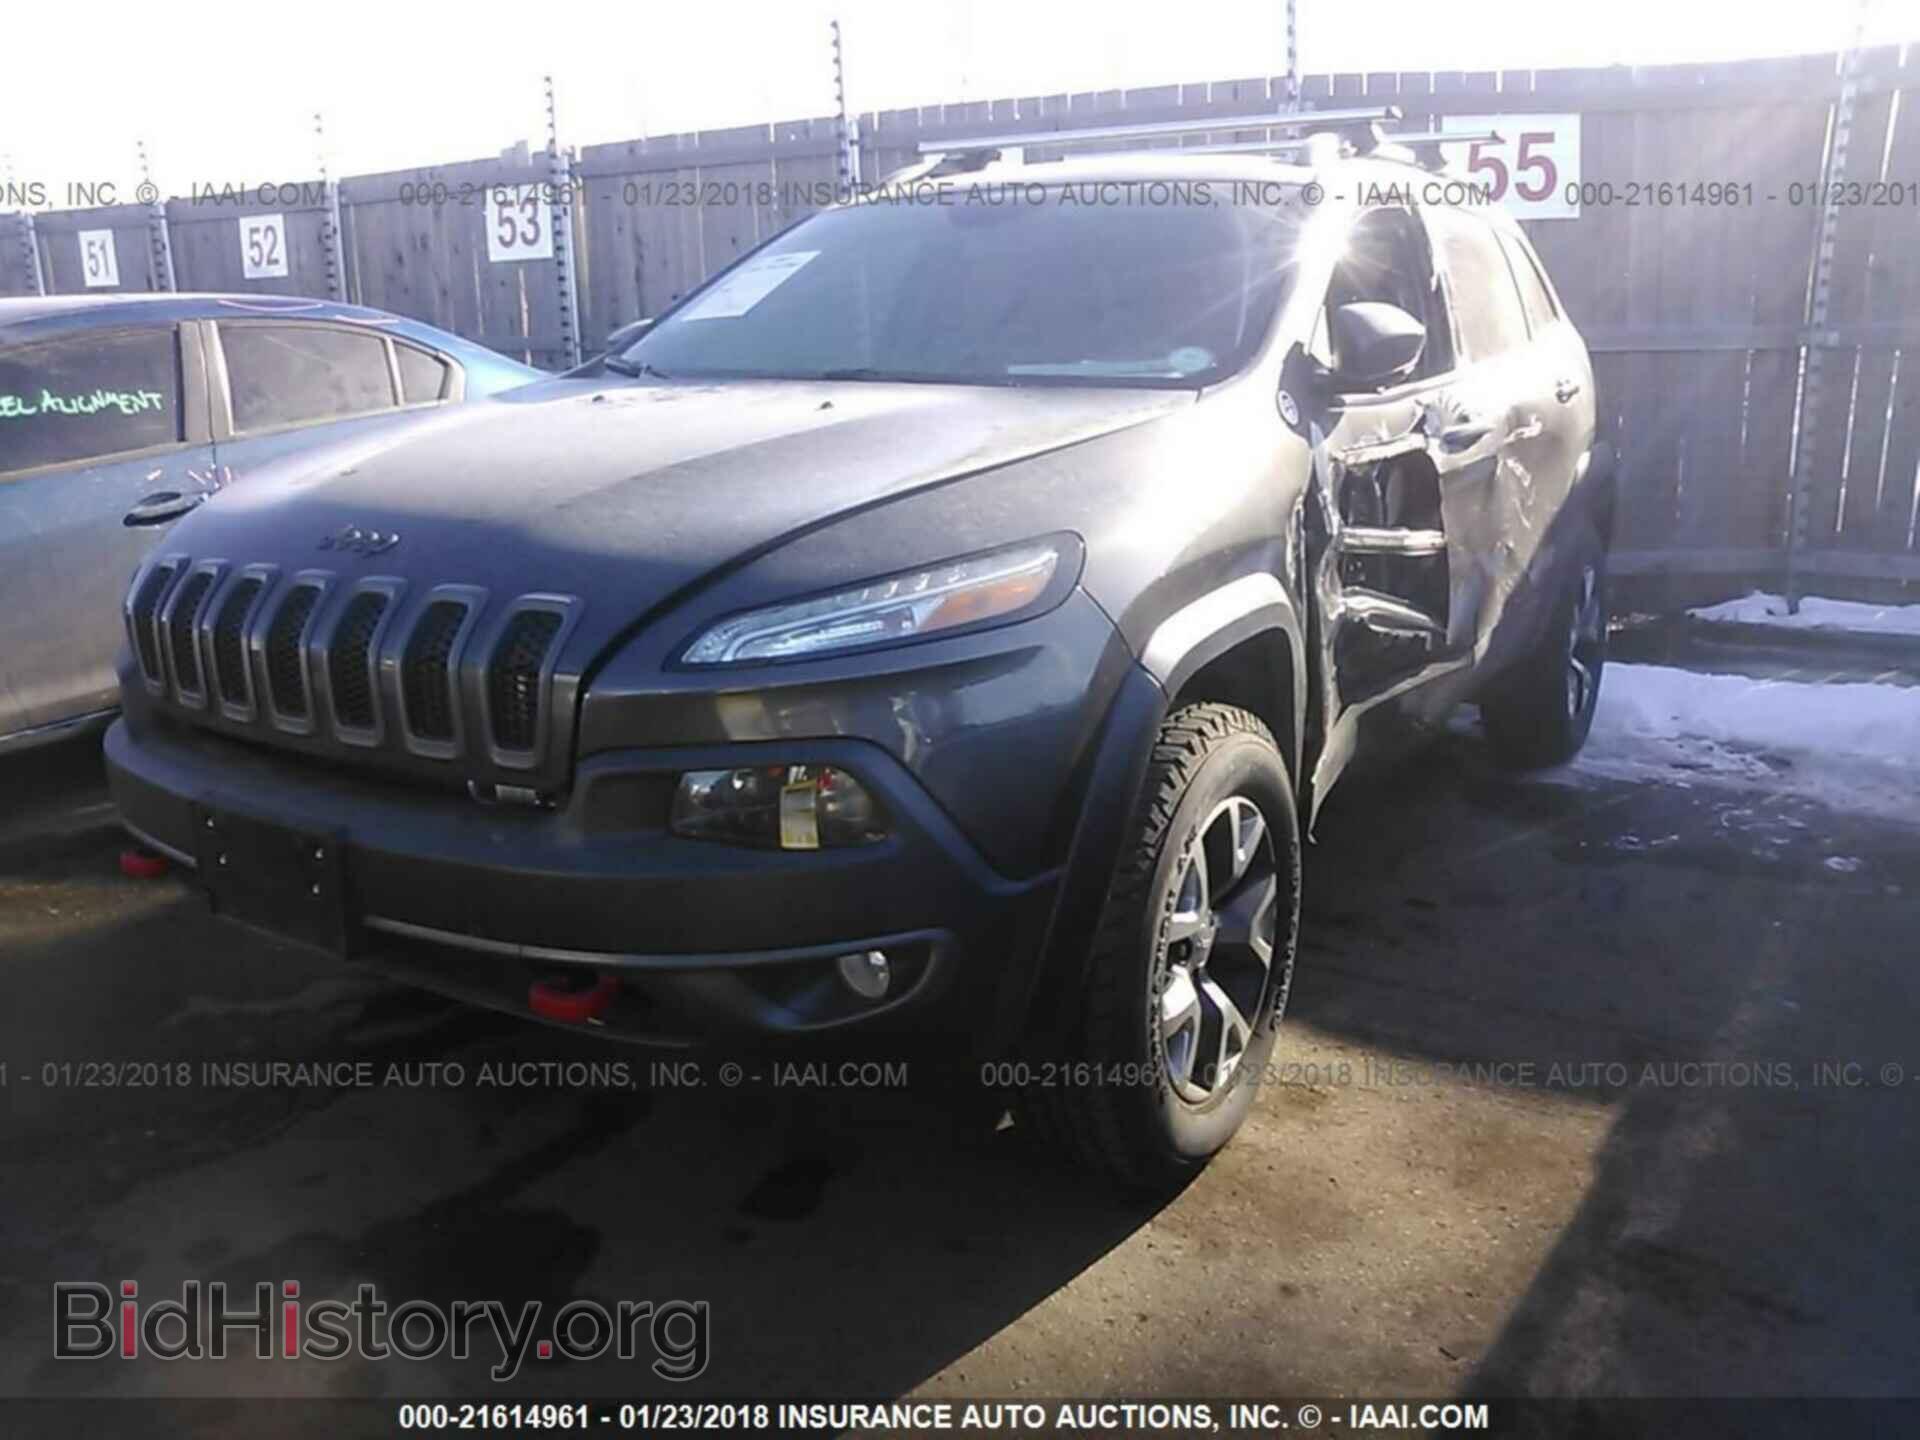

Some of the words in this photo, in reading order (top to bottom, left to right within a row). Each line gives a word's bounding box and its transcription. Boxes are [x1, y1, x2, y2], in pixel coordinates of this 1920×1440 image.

[1468, 132, 1558, 202] 55
[497, 199, 541, 249] 53
[86, 239, 111, 278] 51
[249, 225, 280, 268] 52
[41, 388, 163, 415] ALIGNMENT
